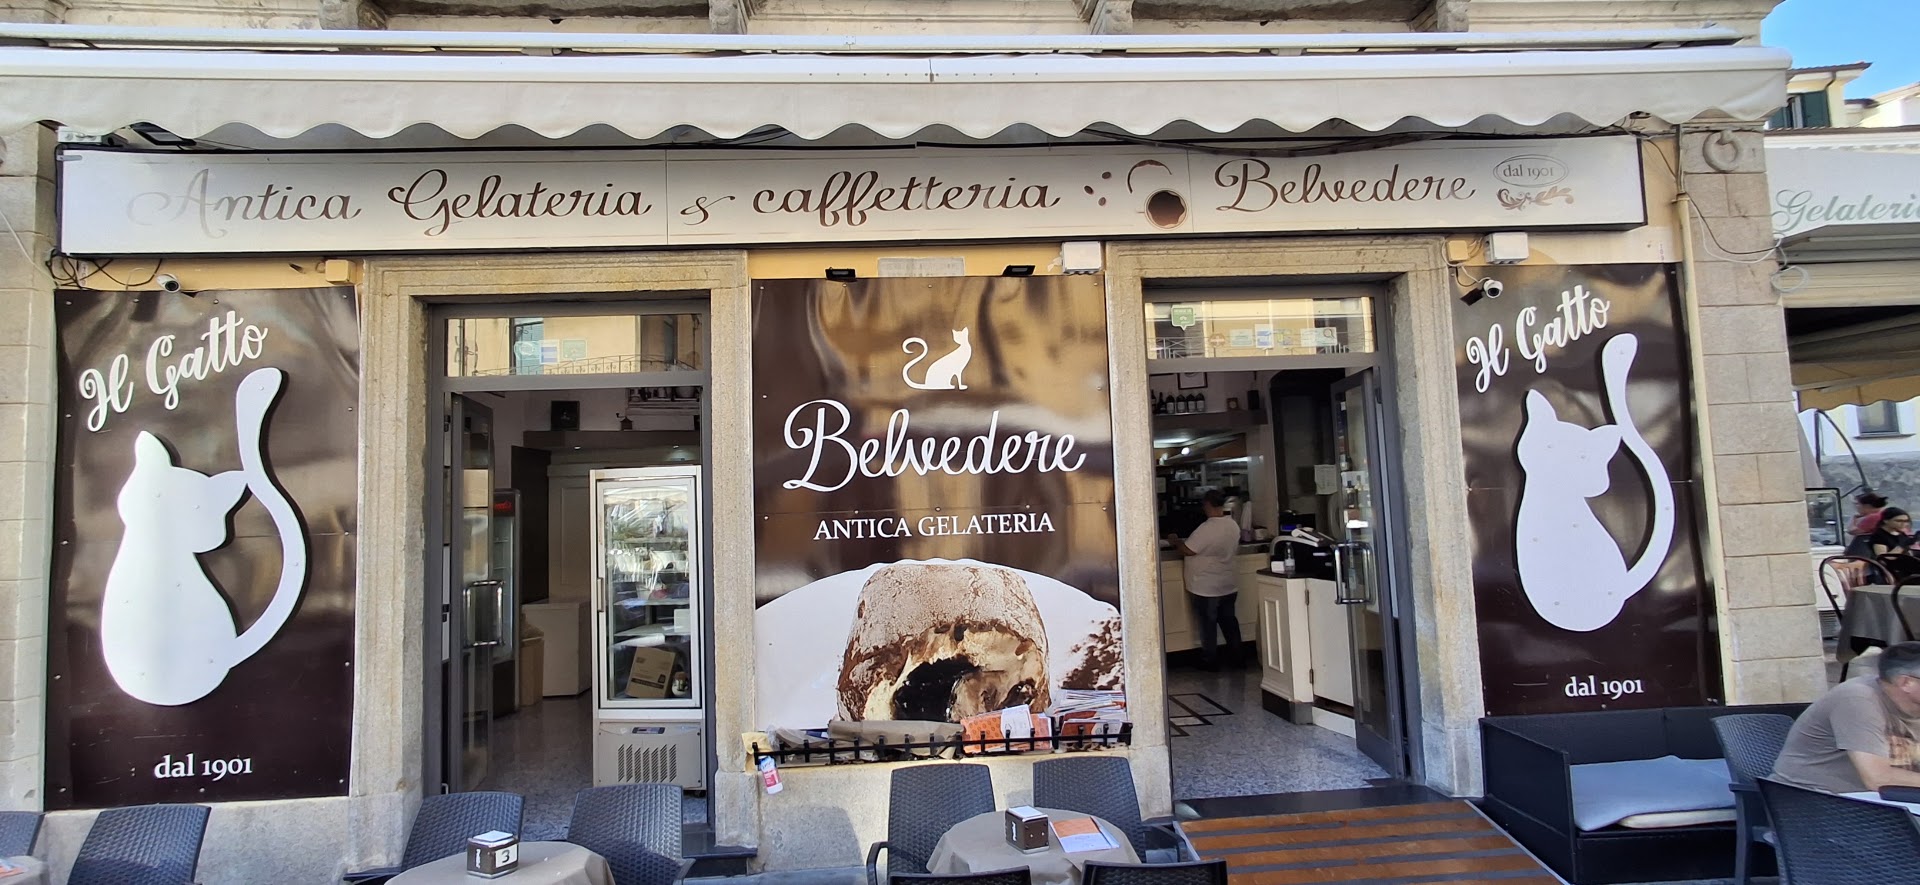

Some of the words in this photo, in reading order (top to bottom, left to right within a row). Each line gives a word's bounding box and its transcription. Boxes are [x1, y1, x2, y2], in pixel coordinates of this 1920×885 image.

[1502, 164, 1523, 177] dal
[1527, 166, 1555, 180] 1901
[126, 168, 362, 239] Antica
[387, 168, 652, 237] Gelateria
[680, 196, 735, 226] &
[751, 170, 1061, 228] caffetteria
[1214, 158, 1476, 212] Belvedere
[1465, 323, 1510, 393] Il
[1515, 284, 1611, 374] Gatto
[78, 353, 134, 432] Il
[145, 310, 269, 410] Gatto
[783, 399, 1086, 492] Belvedere
[813, 517, 912, 541] ANTICA
[918, 511, 1056, 537] GELATERIA
[1564, 674, 1597, 698] dal
[1600, 679, 1644, 700] 1901
[154, 752, 195, 779] dal
[201, 757, 253, 783] 1901
[501, 849, 511, 864] 3
